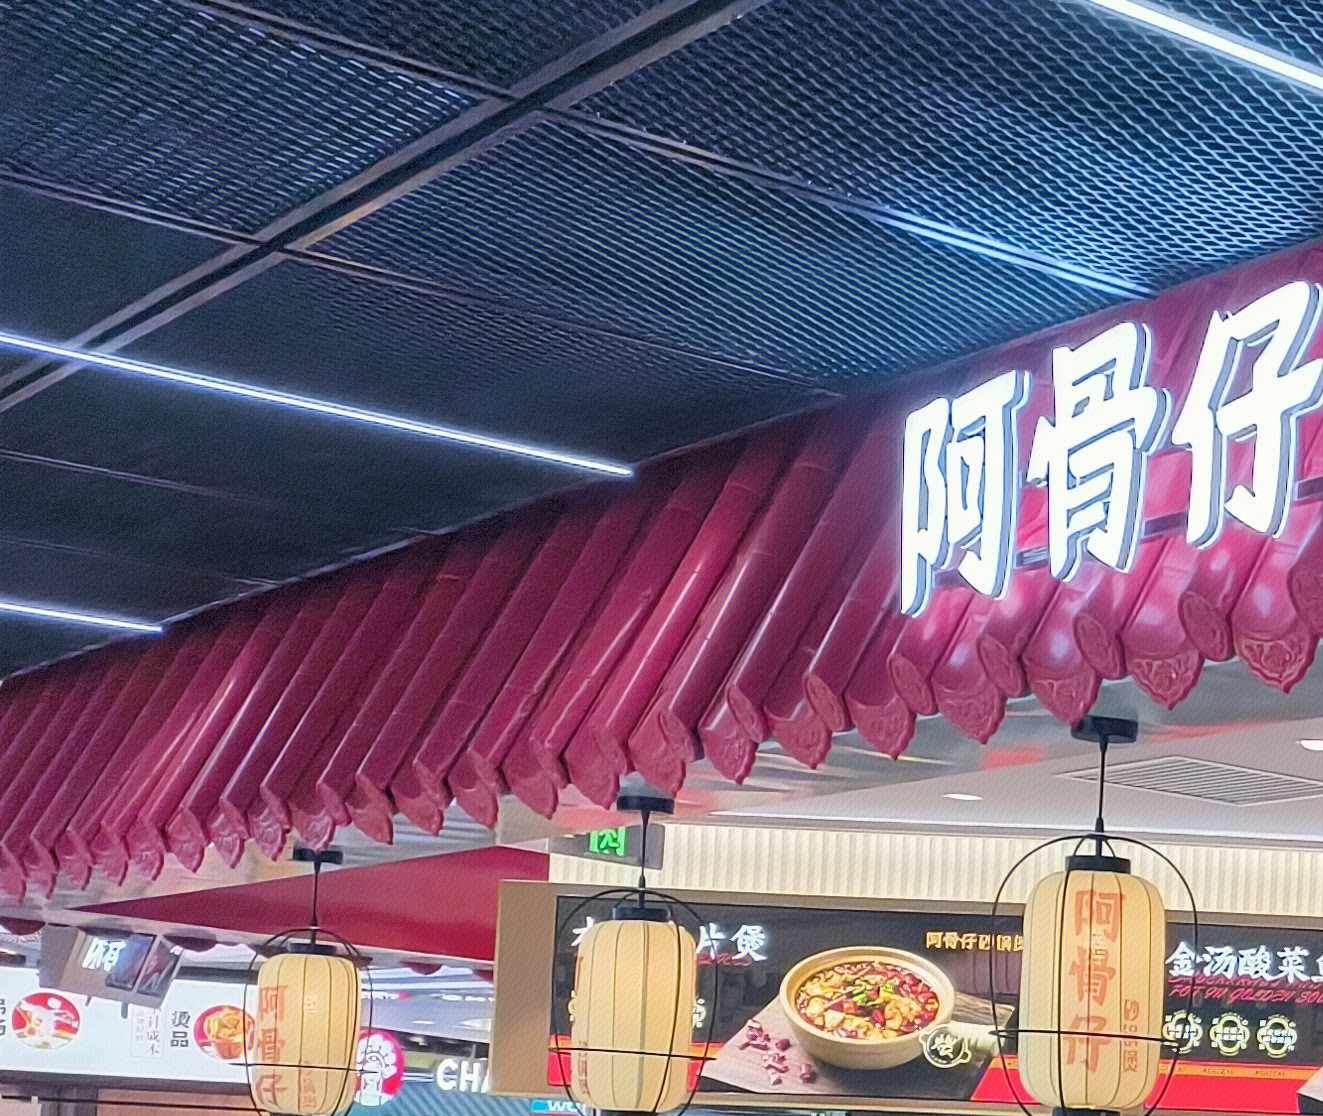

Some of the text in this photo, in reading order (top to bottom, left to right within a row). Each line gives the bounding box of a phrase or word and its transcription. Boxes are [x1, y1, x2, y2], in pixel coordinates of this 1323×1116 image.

[170, 1011, 191, 1048] 烫品
[1066, 890, 1126, 1073] 阿骨仔
